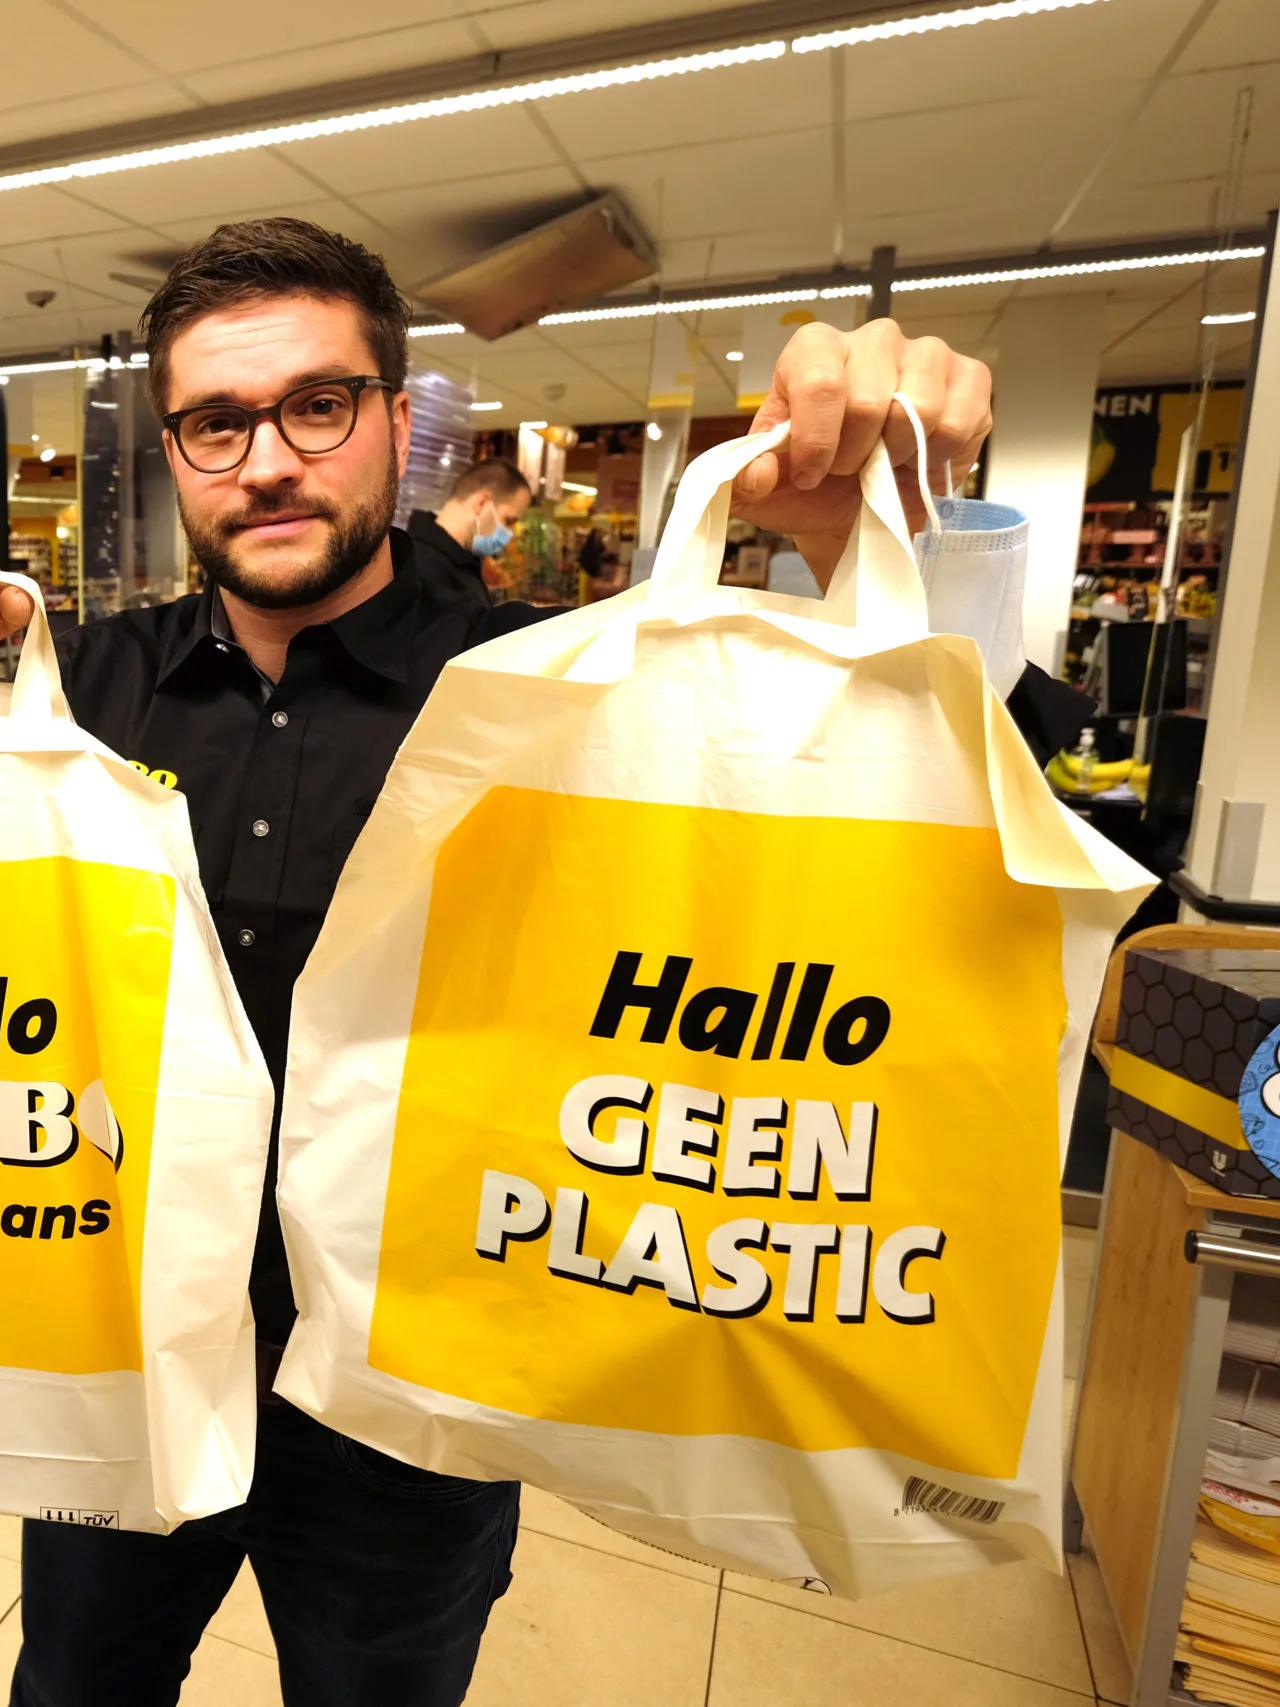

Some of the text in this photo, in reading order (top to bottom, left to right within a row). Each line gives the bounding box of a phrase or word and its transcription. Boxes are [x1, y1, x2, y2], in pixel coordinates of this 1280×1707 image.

[588, 950, 892, 1066] Hallo
[558, 1074, 879, 1202] GEEN
[475, 1169, 946, 1325] PLASTIC
